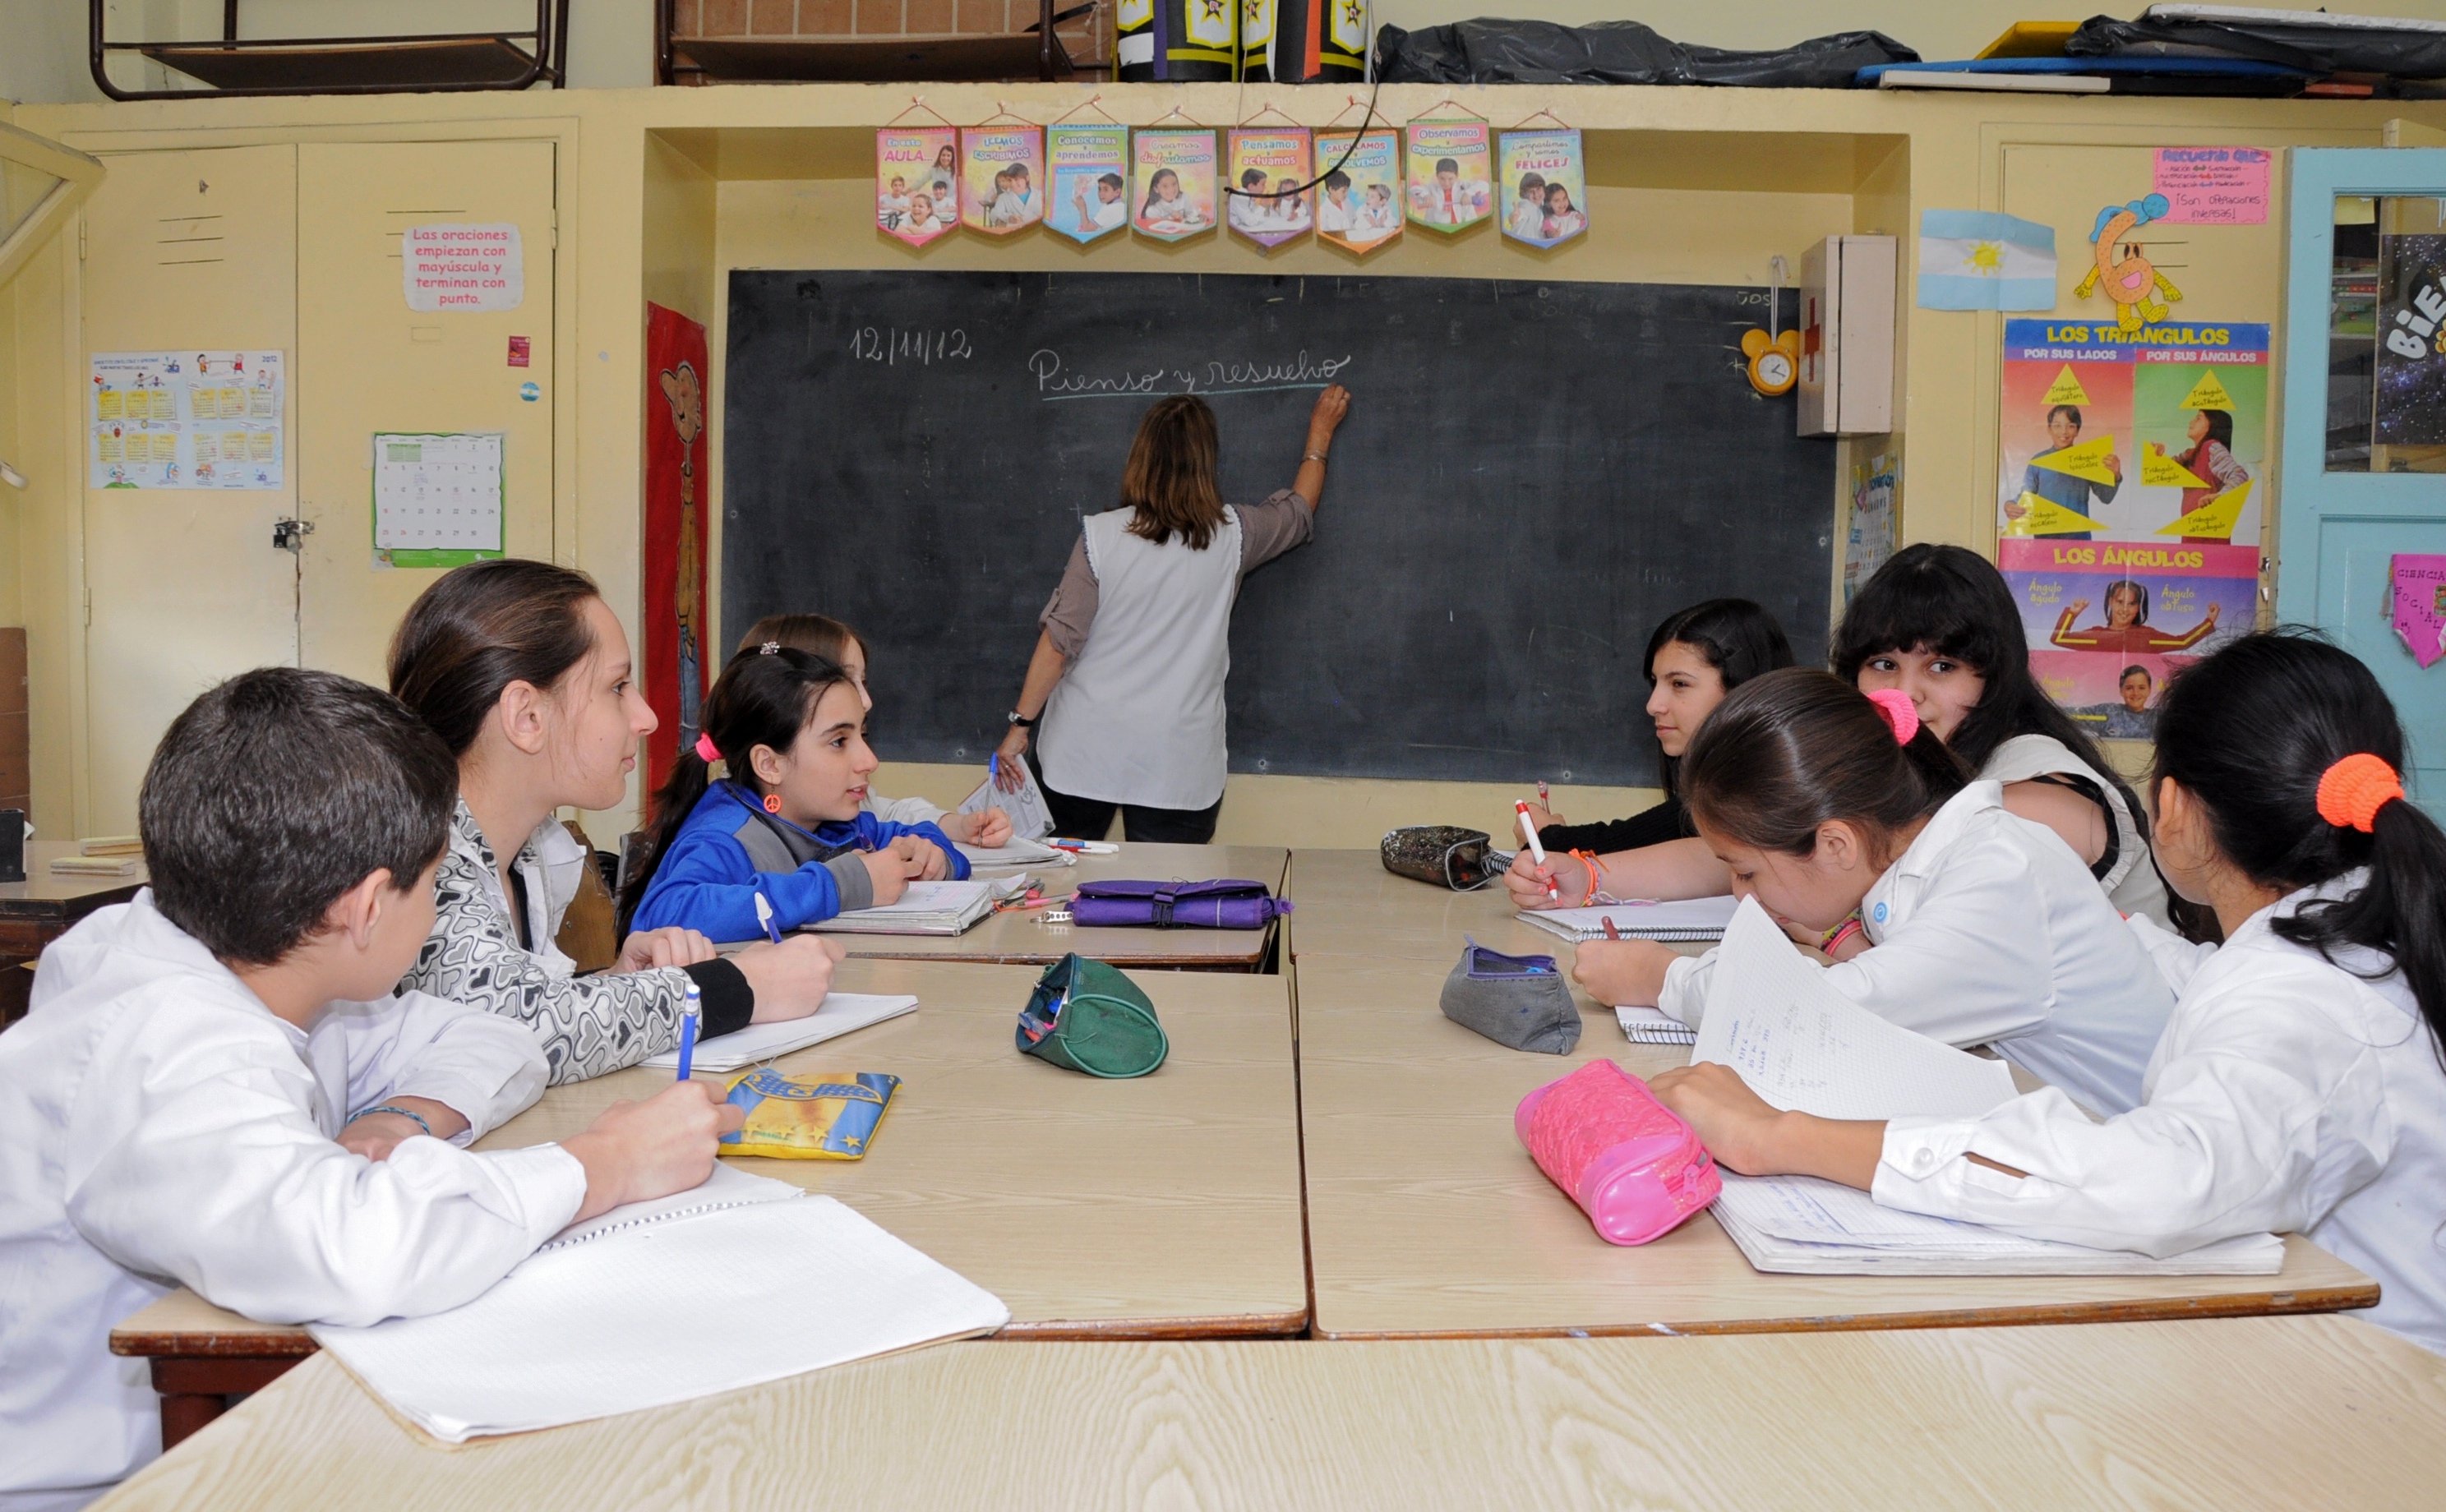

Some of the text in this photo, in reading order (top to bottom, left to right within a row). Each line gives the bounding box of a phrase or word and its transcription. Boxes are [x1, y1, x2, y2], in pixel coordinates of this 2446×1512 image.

[1418, 129, 1479, 140] Observamos
[887, 138, 898, 146] En
[983, 136, 1022, 147] LEEMOS
[1058, 136, 1117, 146] Conocemos
[1151, 139, 1200, 150] Creamos
[1241, 140, 1298, 150] Pensamos
[1326, 141, 1387, 153] CALCLAMOS
[1511, 141, 1569, 151] Compartimos
[973, 148, 1031, 162] ESCRIBIMOS
[1055, 150, 1119, 160] aprendemos
[1411, 142, 1487, 156] experimentamos
[1140, 151, 1211, 168] disfrutamos
[1242, 155, 1296, 166] actuamos
[1515, 157, 1569, 169] FELICES
[413, 228, 508, 240] Las oraciones
[415, 245, 506, 258] empiezan con
[418, 260, 501, 275] mayúscula y
[416, 277, 505, 288] terminan con
[439, 293, 481, 307] punto.
[2047, 326, 2089, 342] LOS
[849, 327, 971, 366] 12/11/12
[2024, 348, 2117, 360] POR SUS LADOS
[2146, 350, 2257, 363] POR SUS ÁNGULOS
[1029, 349, 1351, 393] Pienso y resuelvo
[2051, 383, 2080, 394] Triángulo
[2193, 387, 2222, 398] Triángulo
[2068, 453, 2098, 463] Triángulo
[2144, 465, 2174, 476] Triángulo
[2187, 514, 2218, 526] Triángulo
[2054, 546, 2204, 568] LOS ÁNGULOS
[2028, 579, 2063, 595] Ángulo
[2161, 584, 2195, 600] Ángulo
[2030, 592, 2061, 607] agudo
[2160, 599, 2194, 612] obtuso
